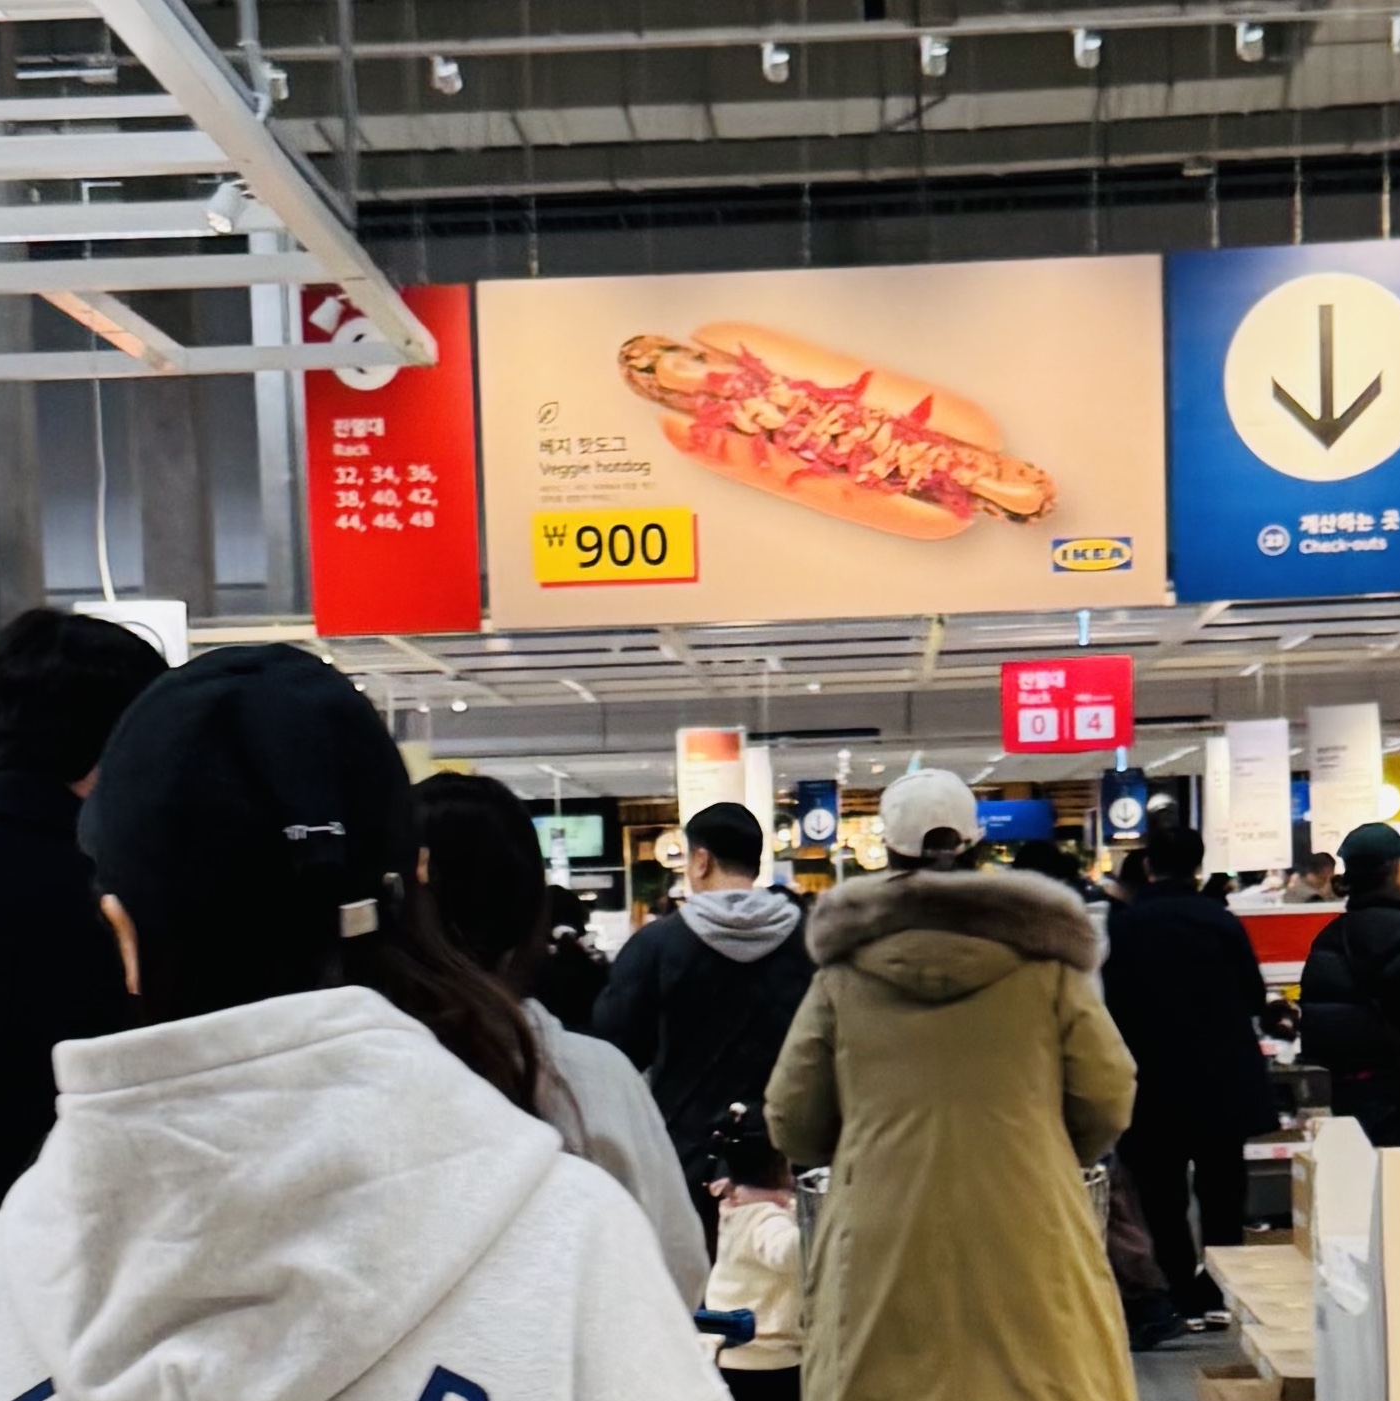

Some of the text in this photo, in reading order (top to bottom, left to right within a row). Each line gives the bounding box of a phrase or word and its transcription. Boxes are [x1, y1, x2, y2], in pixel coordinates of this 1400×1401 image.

[539, 436, 628, 455] 베지 핫도그
[334, 466, 365, 486] 32,
[369, 465, 401, 486] 34,
[539, 459, 652, 480] Veggie hotdog
[407, 487, 439, 507] 42,
[334, 513, 367, 532] 44,
[1299, 511, 1375, 535] 계산하는
[1380, 508, 1400, 531] 곳
[1031, 712, 1103, 735] 0 4
